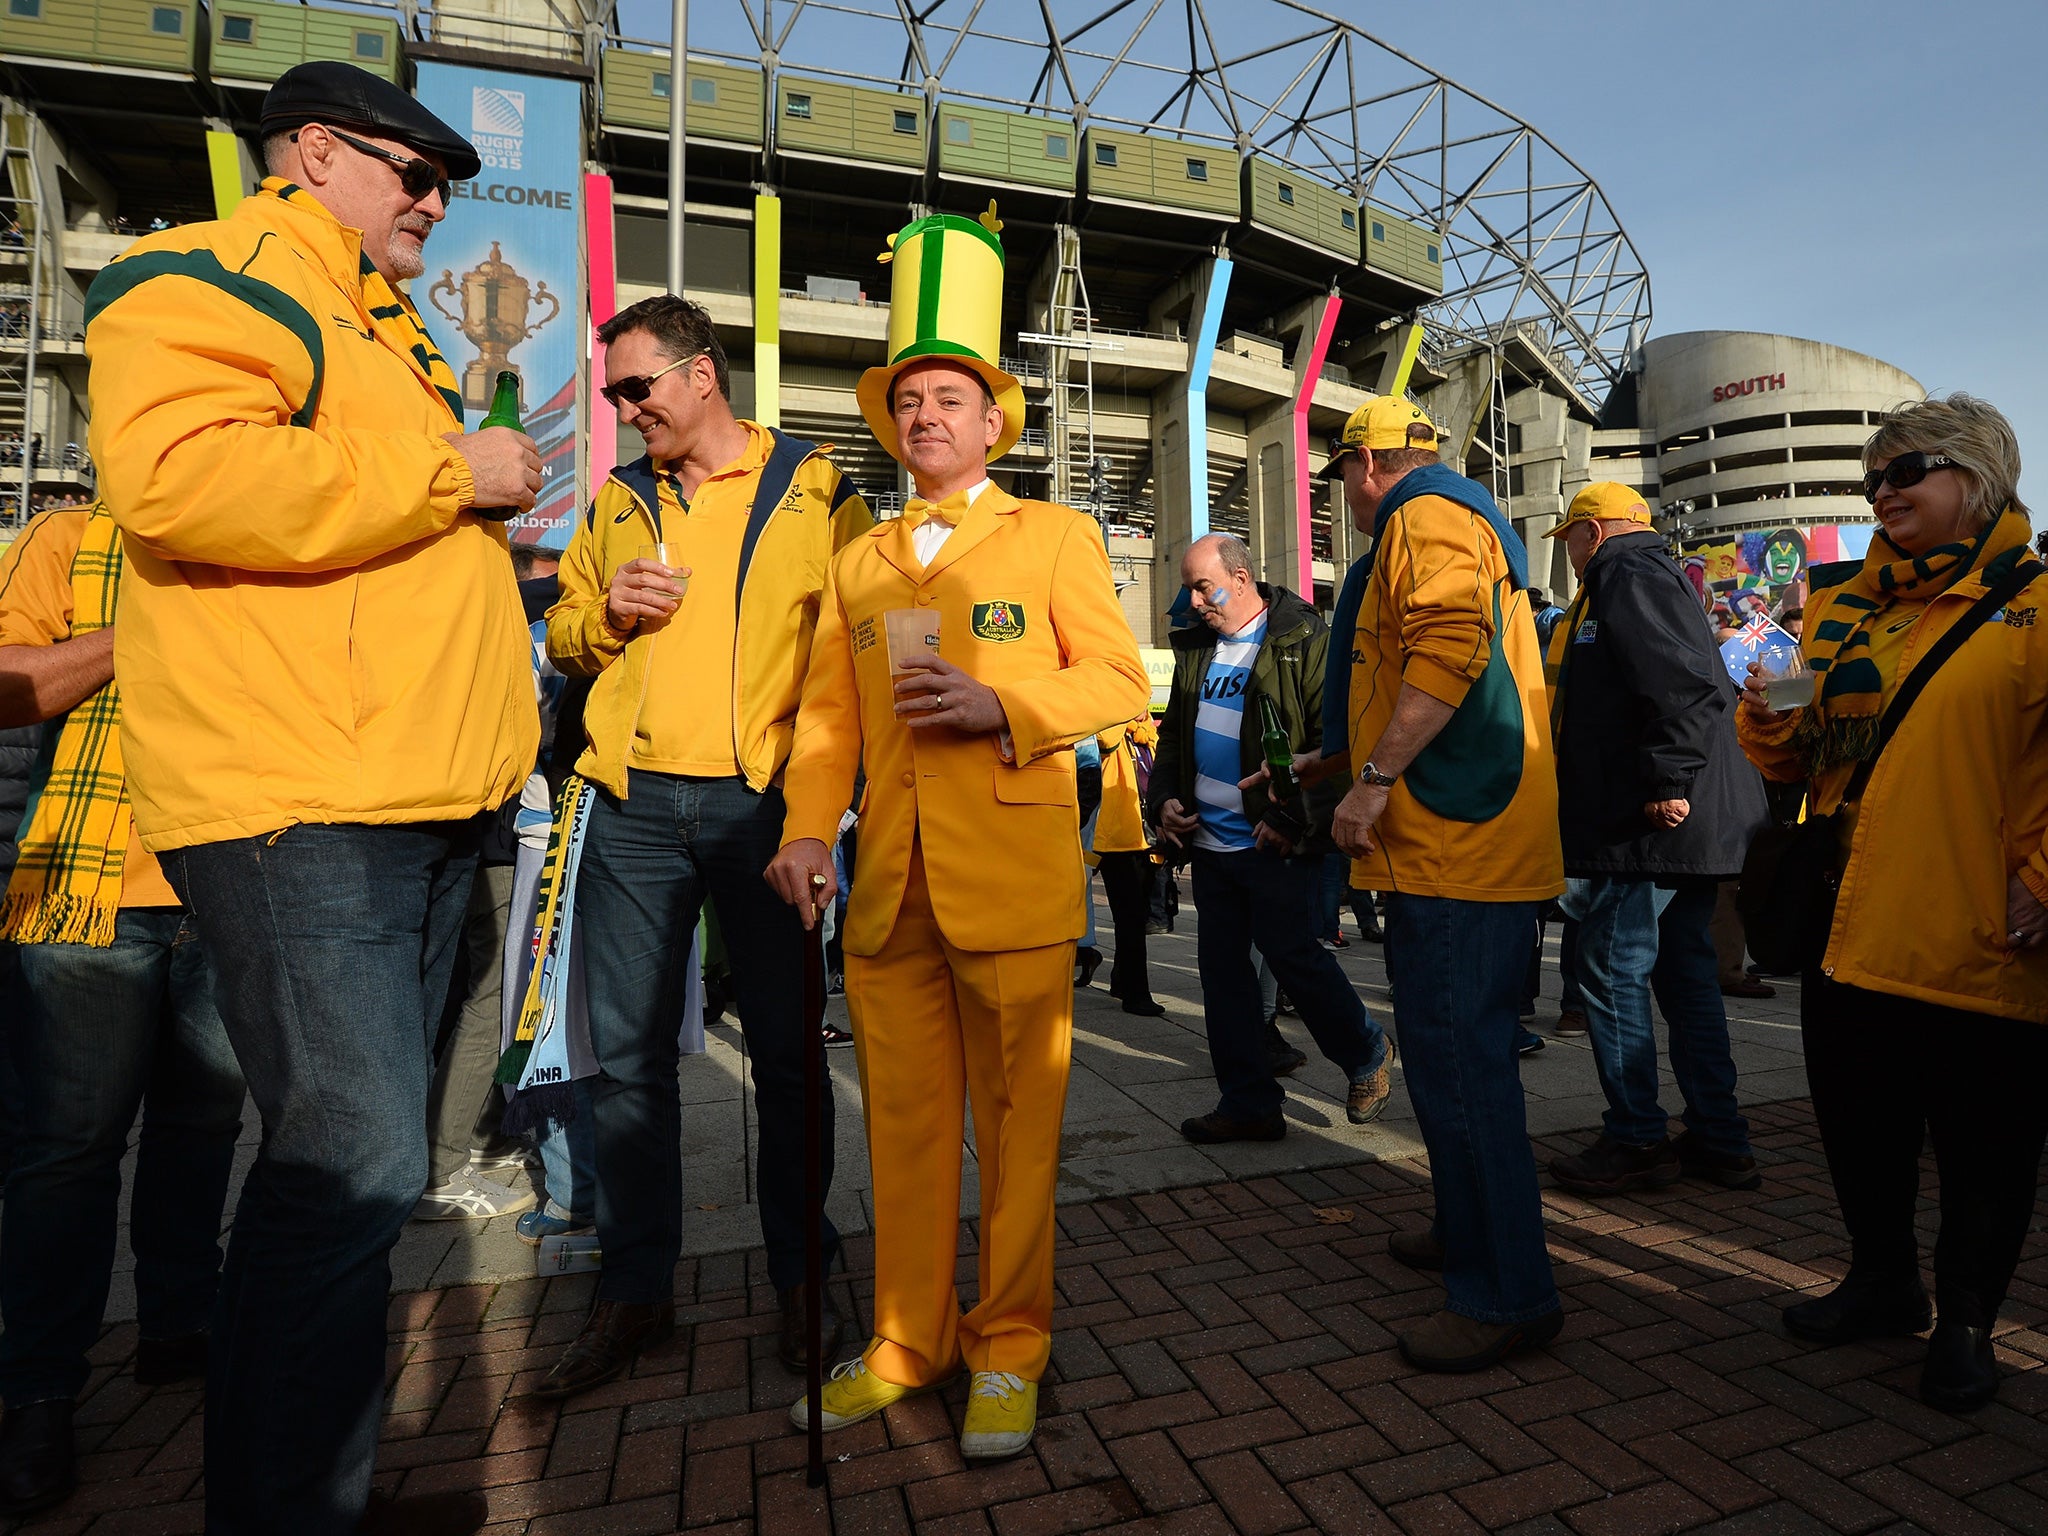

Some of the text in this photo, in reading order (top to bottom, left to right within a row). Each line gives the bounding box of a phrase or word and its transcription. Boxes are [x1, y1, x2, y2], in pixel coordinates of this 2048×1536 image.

[471, 133, 523, 150] RUGBY
[505, 150, 523, 158] CUP
[483, 155, 523, 171] 015
[452, 181, 572, 210] ELCOME
[1713, 372, 1786, 403] SOUTH
[505, 517, 570, 529] RLDCUP
[2004, 618, 2034, 628] 205
